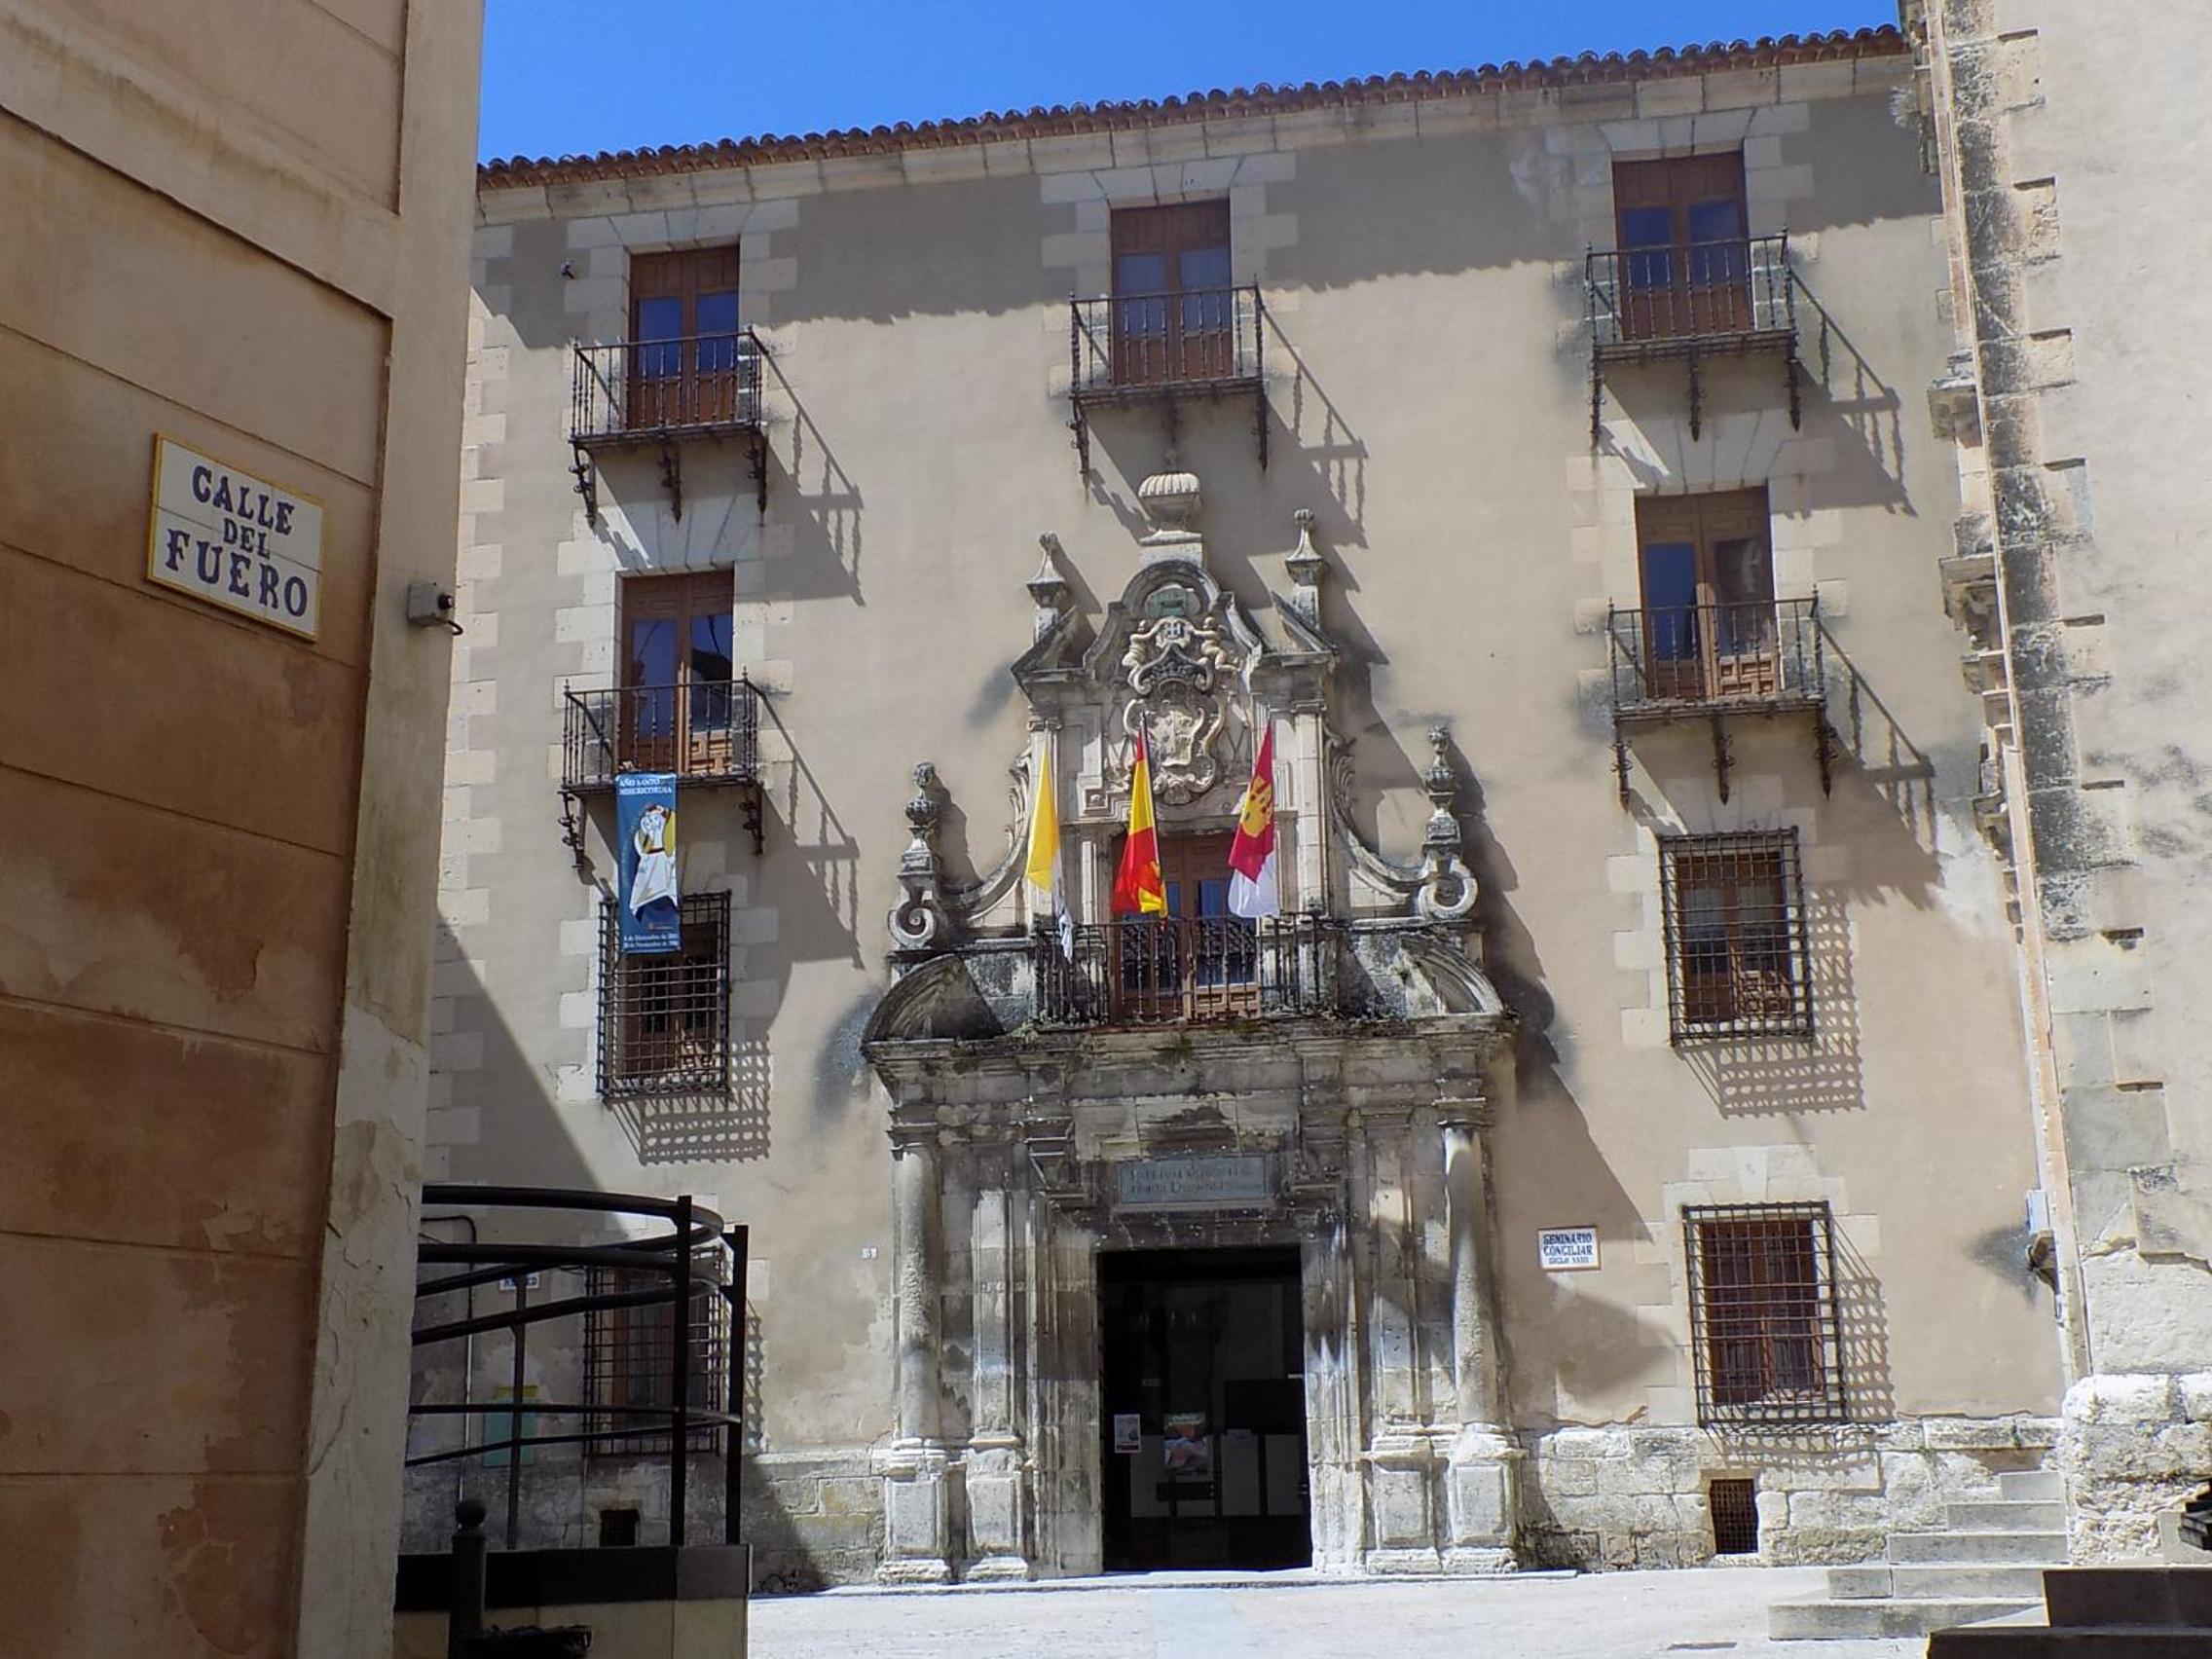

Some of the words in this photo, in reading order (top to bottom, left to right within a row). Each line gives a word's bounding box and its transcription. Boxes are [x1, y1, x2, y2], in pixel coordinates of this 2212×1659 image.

[192, 465, 294, 535] CALLE
[223, 518, 271, 560] DEL
[166, 528, 308, 617] FUERO
[1543, 1233, 1592, 1245] SEMINARIO
[1543, 1245, 1593, 1256] CONCILIAR
